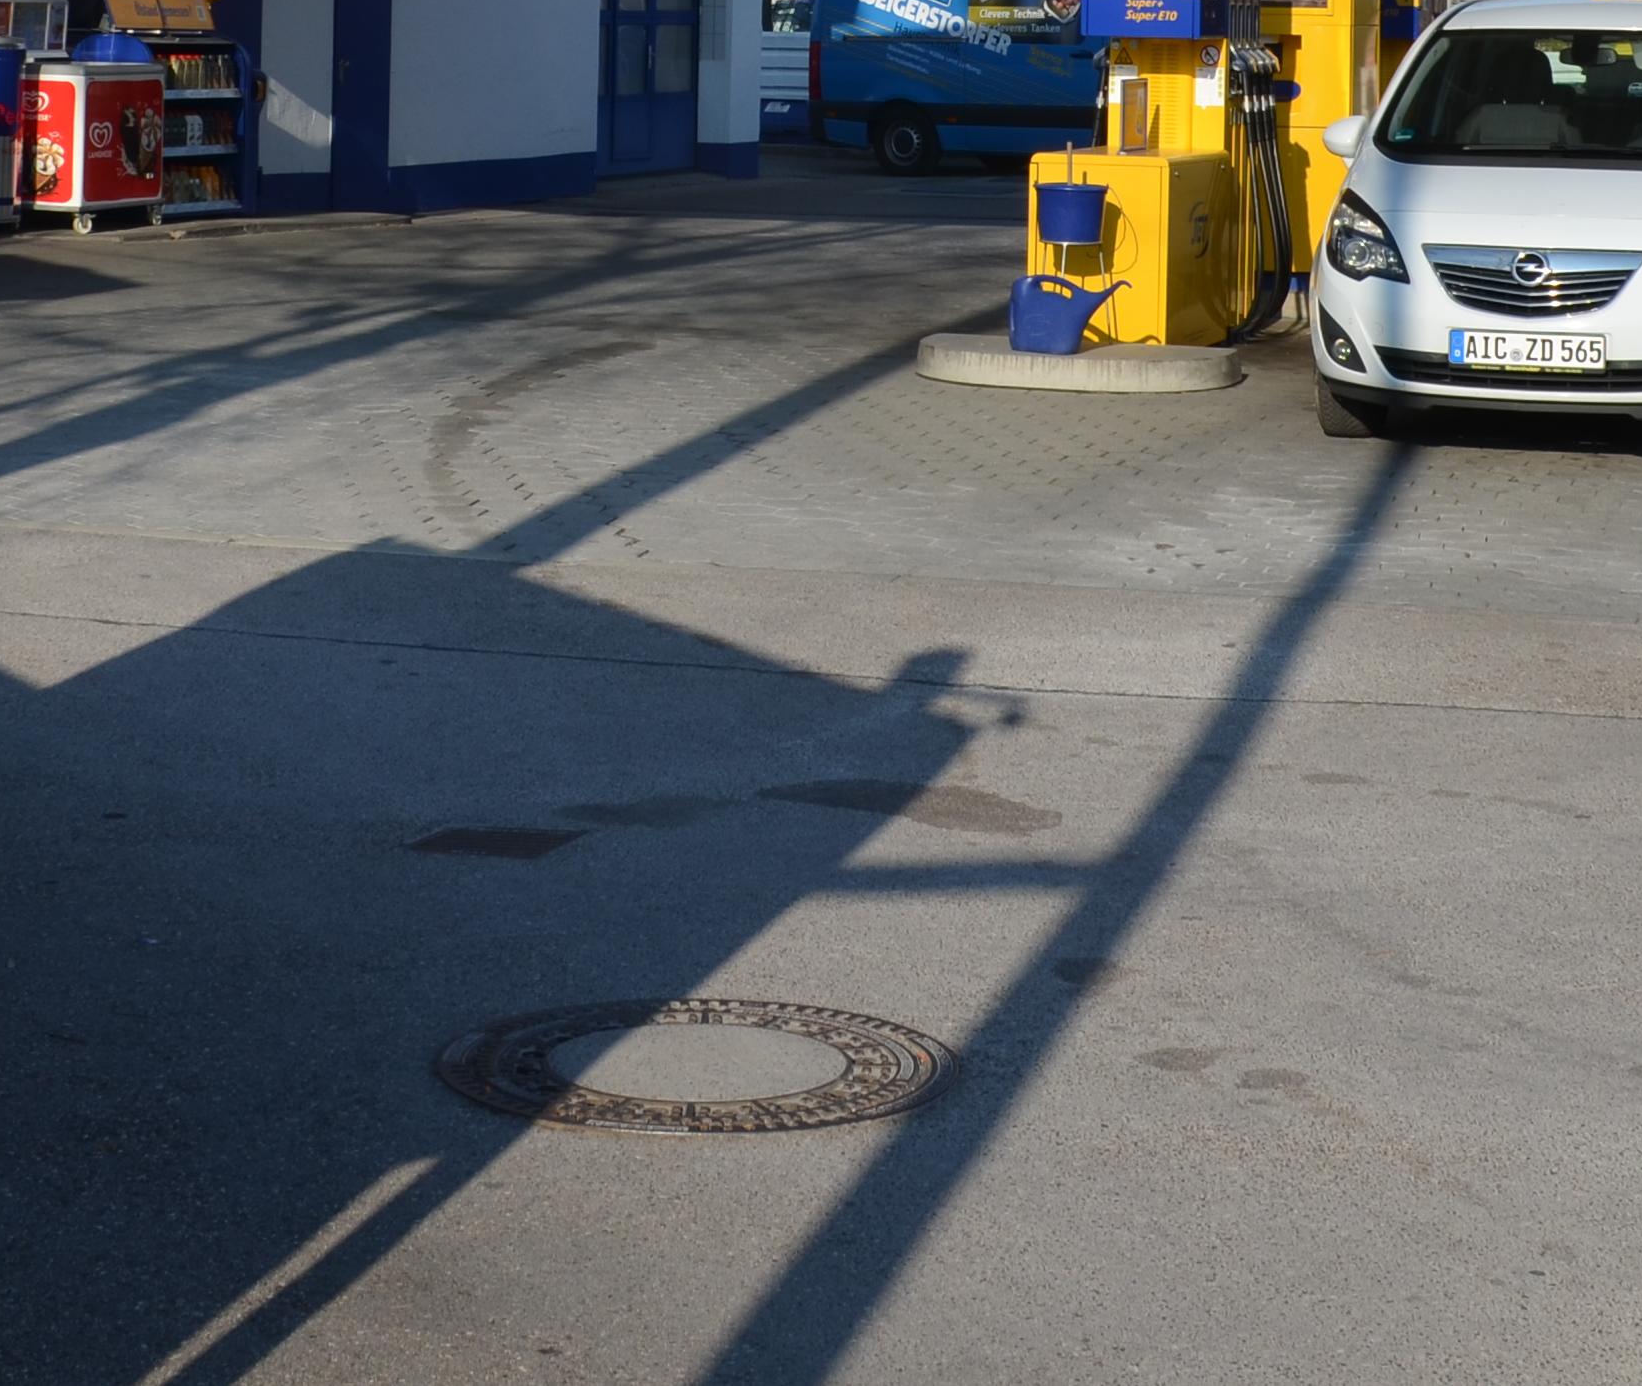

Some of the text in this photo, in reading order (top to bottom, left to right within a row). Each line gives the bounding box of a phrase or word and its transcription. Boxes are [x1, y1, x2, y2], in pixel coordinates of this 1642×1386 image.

[979, 7, 1046, 19] Clevere Technik
[1125, 10, 1179, 23] Super E10
[1031, 23, 1061, 33] Tanken
[1466, 336, 1602, 364] AIC ZD 565
